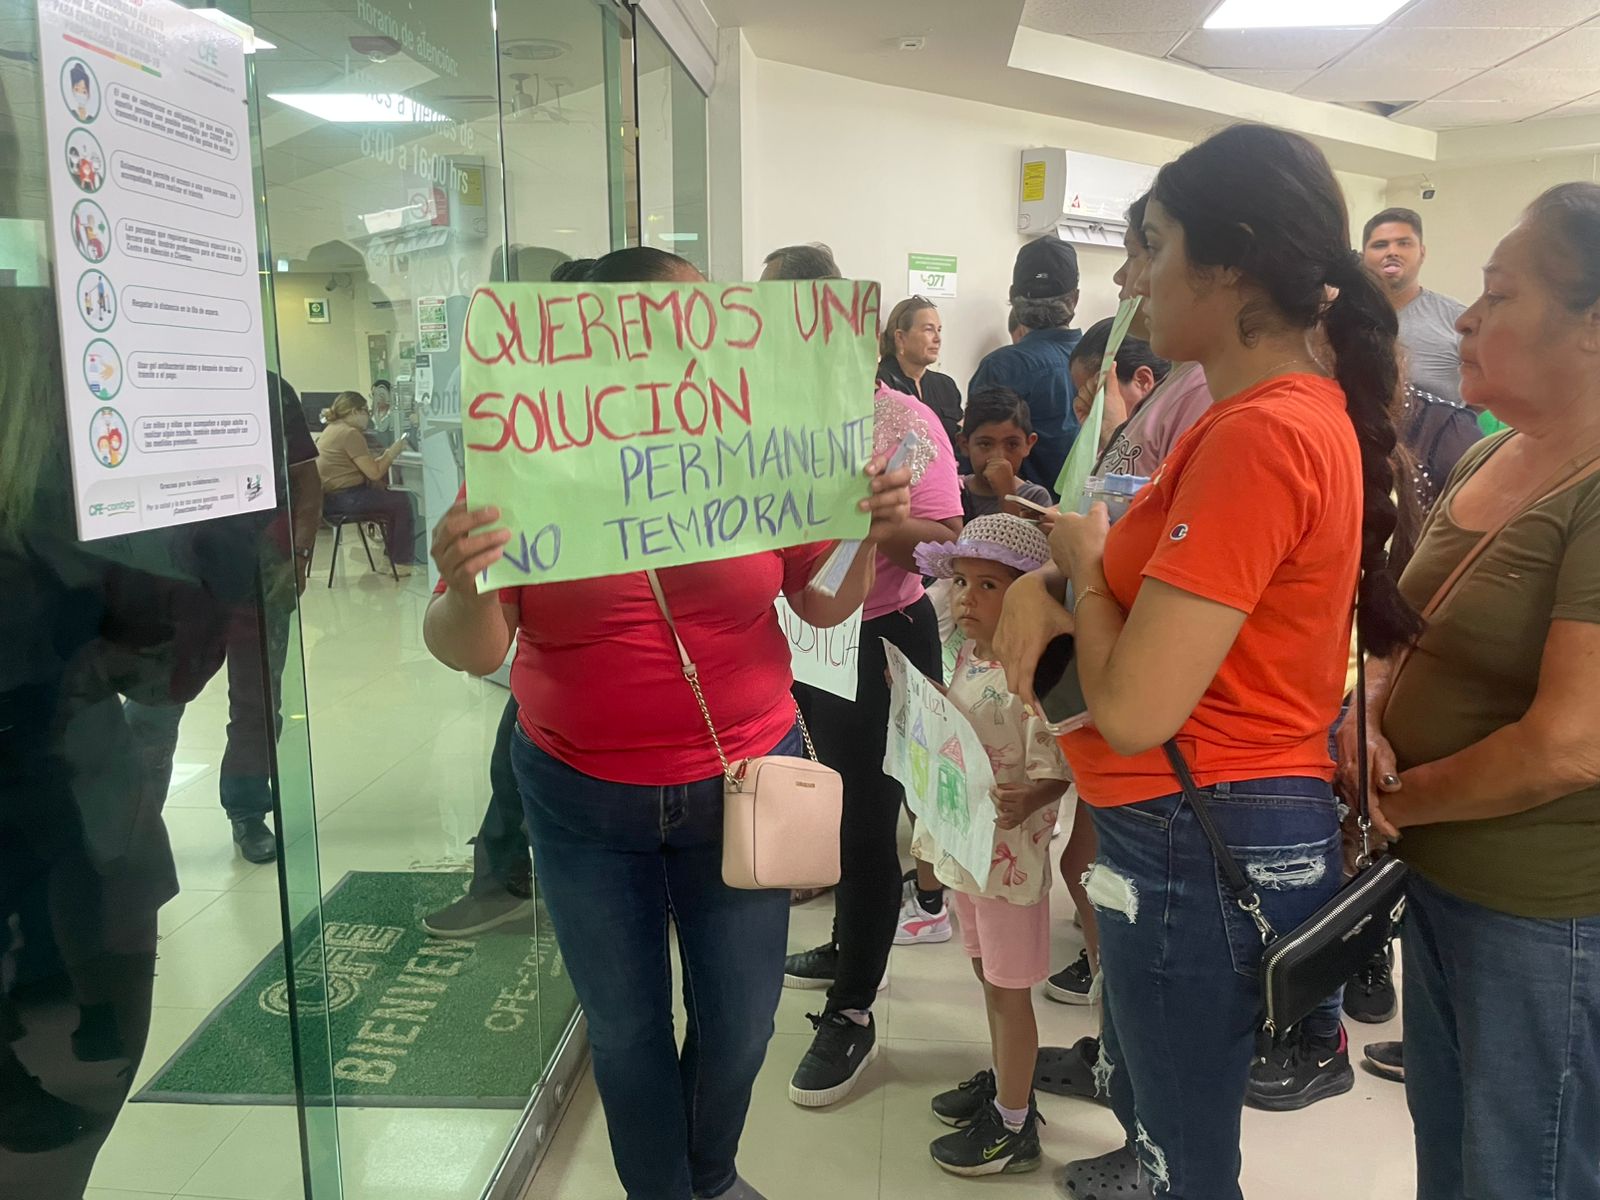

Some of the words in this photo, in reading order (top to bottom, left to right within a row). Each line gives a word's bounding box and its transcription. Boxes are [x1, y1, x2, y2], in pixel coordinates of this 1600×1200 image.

[357, 0, 398, 41] Horario
[402, 23, 414, 50] de
[417, 31, 458, 77] atención:
[361, 127, 394, 165] 8:00
[398, 145, 406, 170] a
[413, 144, 446, 185] 16:00
[450, 160, 468, 194] hrs
[460, 119, 474, 150] de
[464, 286, 762, 368] QUEREMOS
[793, 280, 881, 346] UNA
[467, 358, 752, 455] SOLUCIÓN
[620, 415, 875, 507] PERMANENTE
[480, 522, 561, 586] NO
[604, 486, 831, 560] TEMPORAL
[260, 921, 407, 1017] CFE
